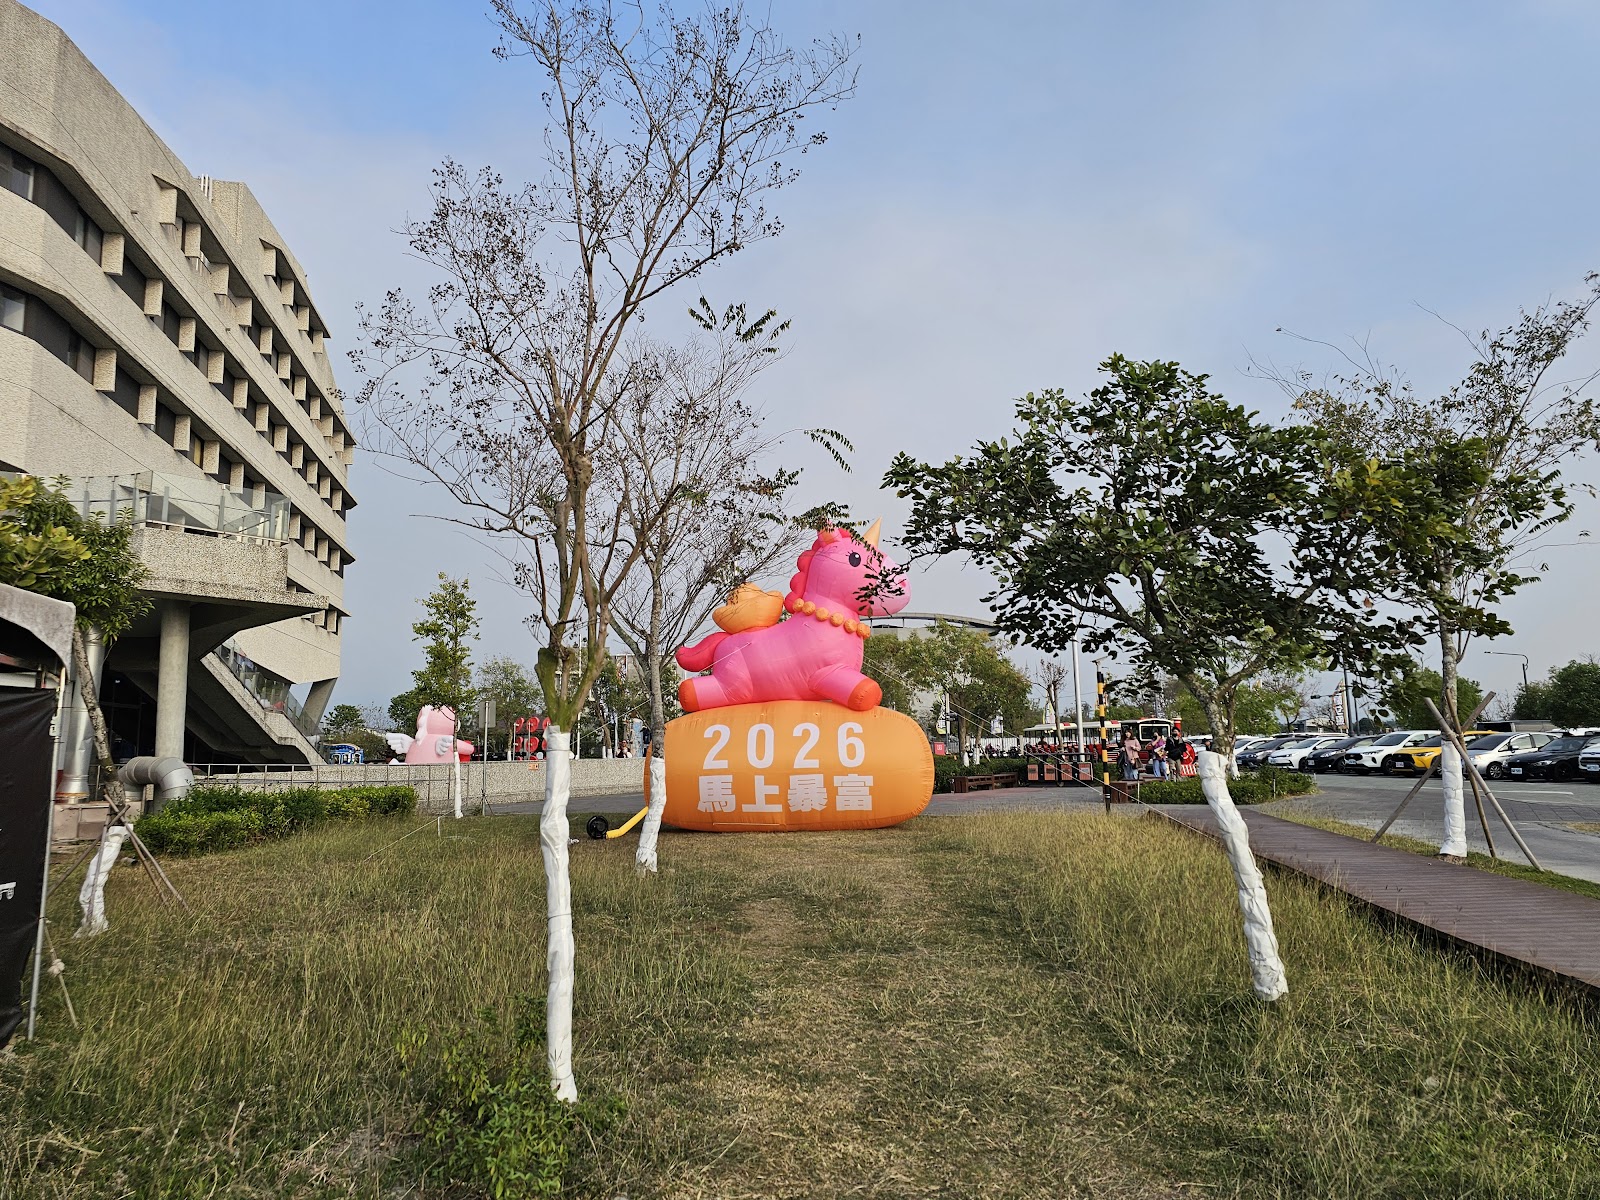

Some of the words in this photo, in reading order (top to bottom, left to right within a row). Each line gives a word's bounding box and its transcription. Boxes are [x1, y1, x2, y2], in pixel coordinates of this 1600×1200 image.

[703, 722, 866, 770] 2026
[698, 774, 874, 812] 馬上暴富
